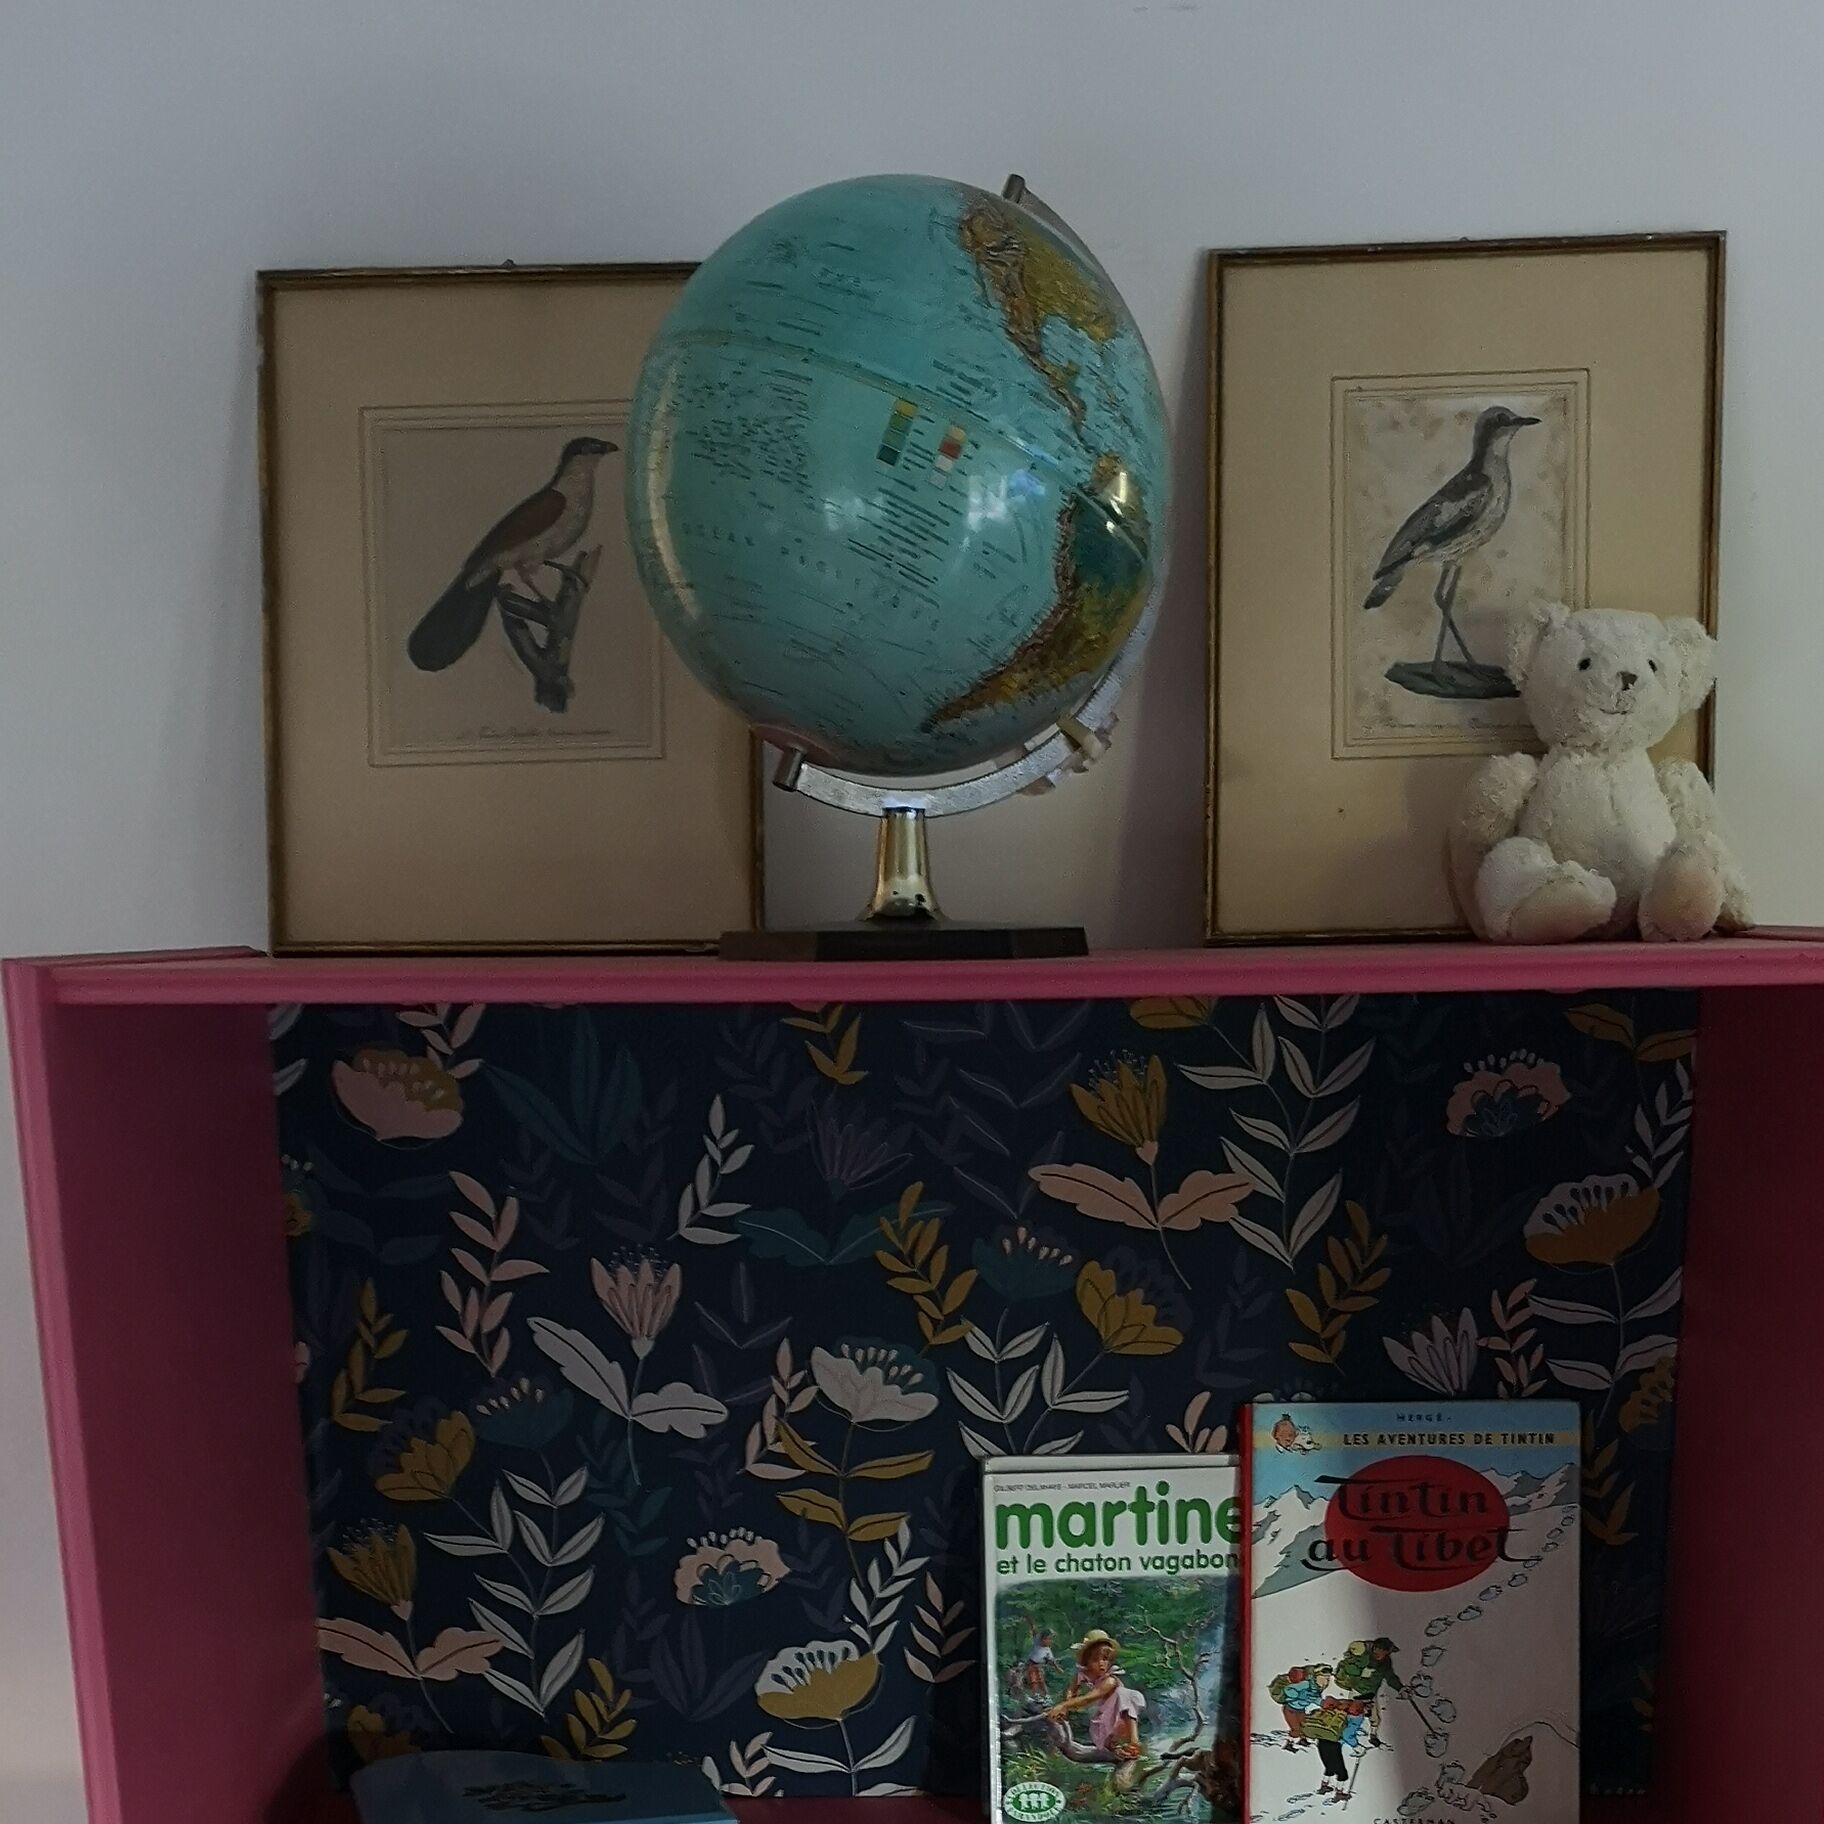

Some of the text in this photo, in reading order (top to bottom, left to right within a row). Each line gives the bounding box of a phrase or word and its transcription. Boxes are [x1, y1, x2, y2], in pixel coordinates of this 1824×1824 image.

[1343, 1432, 1555, 1446] LES AVENTURES DE TINTIN
[995, 1480, 1241, 1550] martine
[1314, 1474, 1487, 1521] Tintin
[996, 1549, 1241, 1575] et le chaton vagabon
[1369, 1523, 1544, 1572] Tibet
